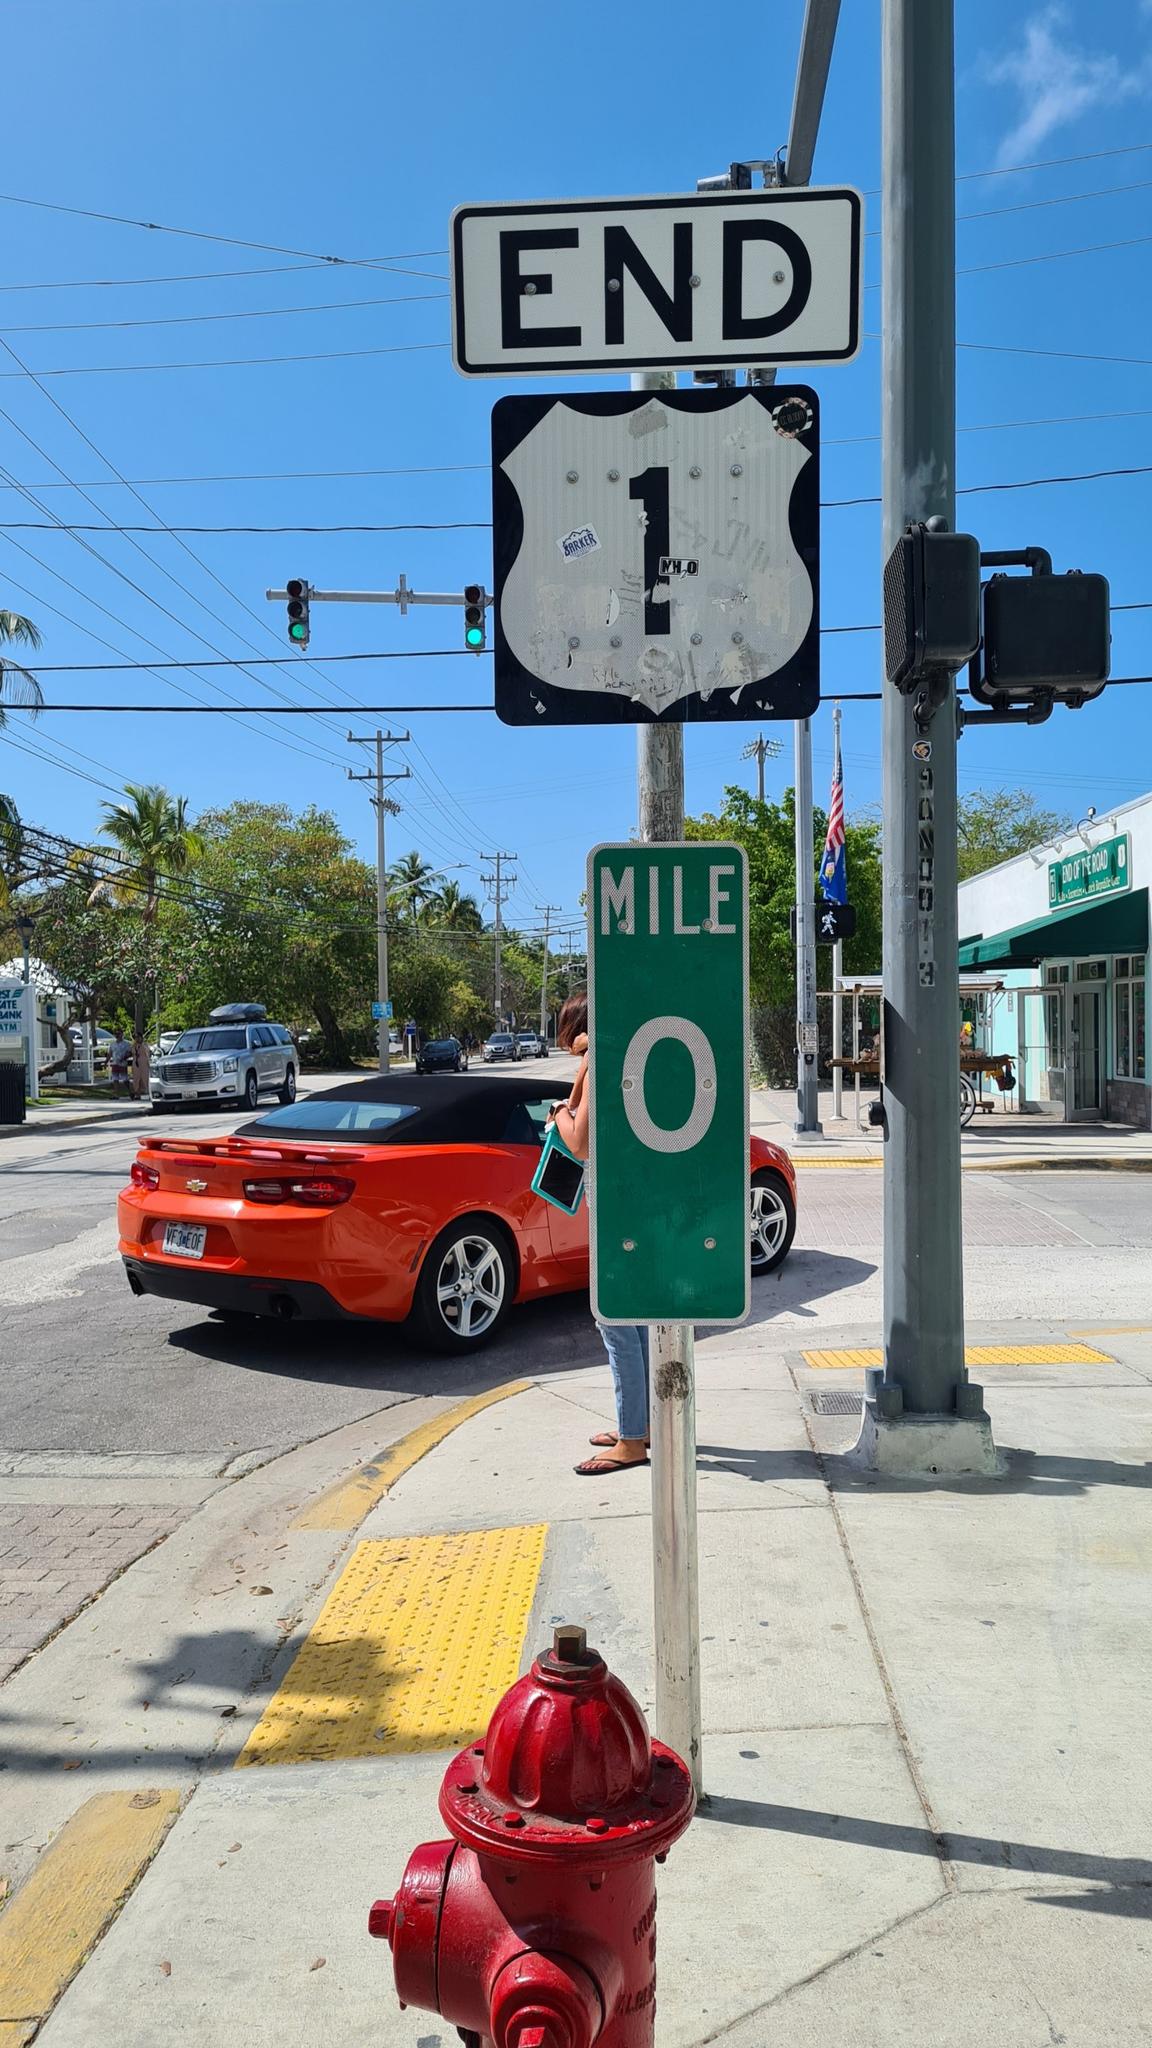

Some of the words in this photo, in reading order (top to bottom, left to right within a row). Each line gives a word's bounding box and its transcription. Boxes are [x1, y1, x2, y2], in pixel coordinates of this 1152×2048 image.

[500, 218, 812, 349] END
[564, 533, 597, 557] BARKER
[629, 466, 671, 635] 1
[601, 865, 736, 935] MILE
[1062, 863, 1073, 884] END
[1073, 859, 1081, 880] OF
[1092, 848, 1108, 875] ROAD
[0, 1000, 17, 1009] ATE
[622, 1015, 717, 1153] 0
